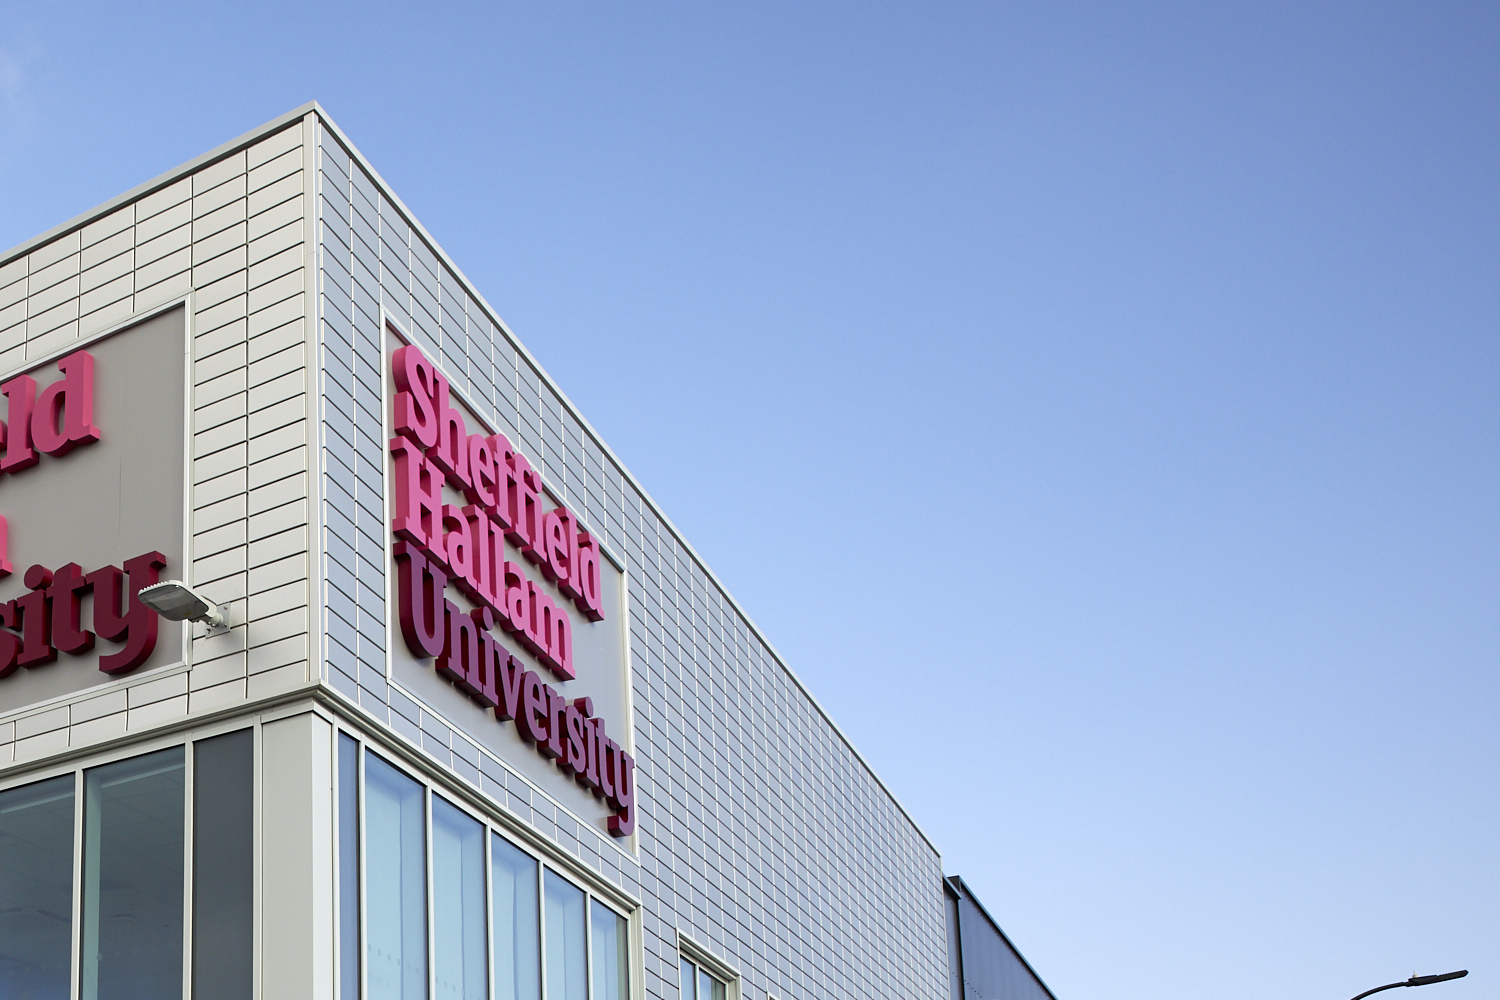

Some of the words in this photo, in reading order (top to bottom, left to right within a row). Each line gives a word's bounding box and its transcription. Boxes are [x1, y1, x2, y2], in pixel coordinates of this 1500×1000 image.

[390, 435, 575, 680] Hallam
[392, 345, 604, 621] Sheffield
[393, 540, 635, 836] University
